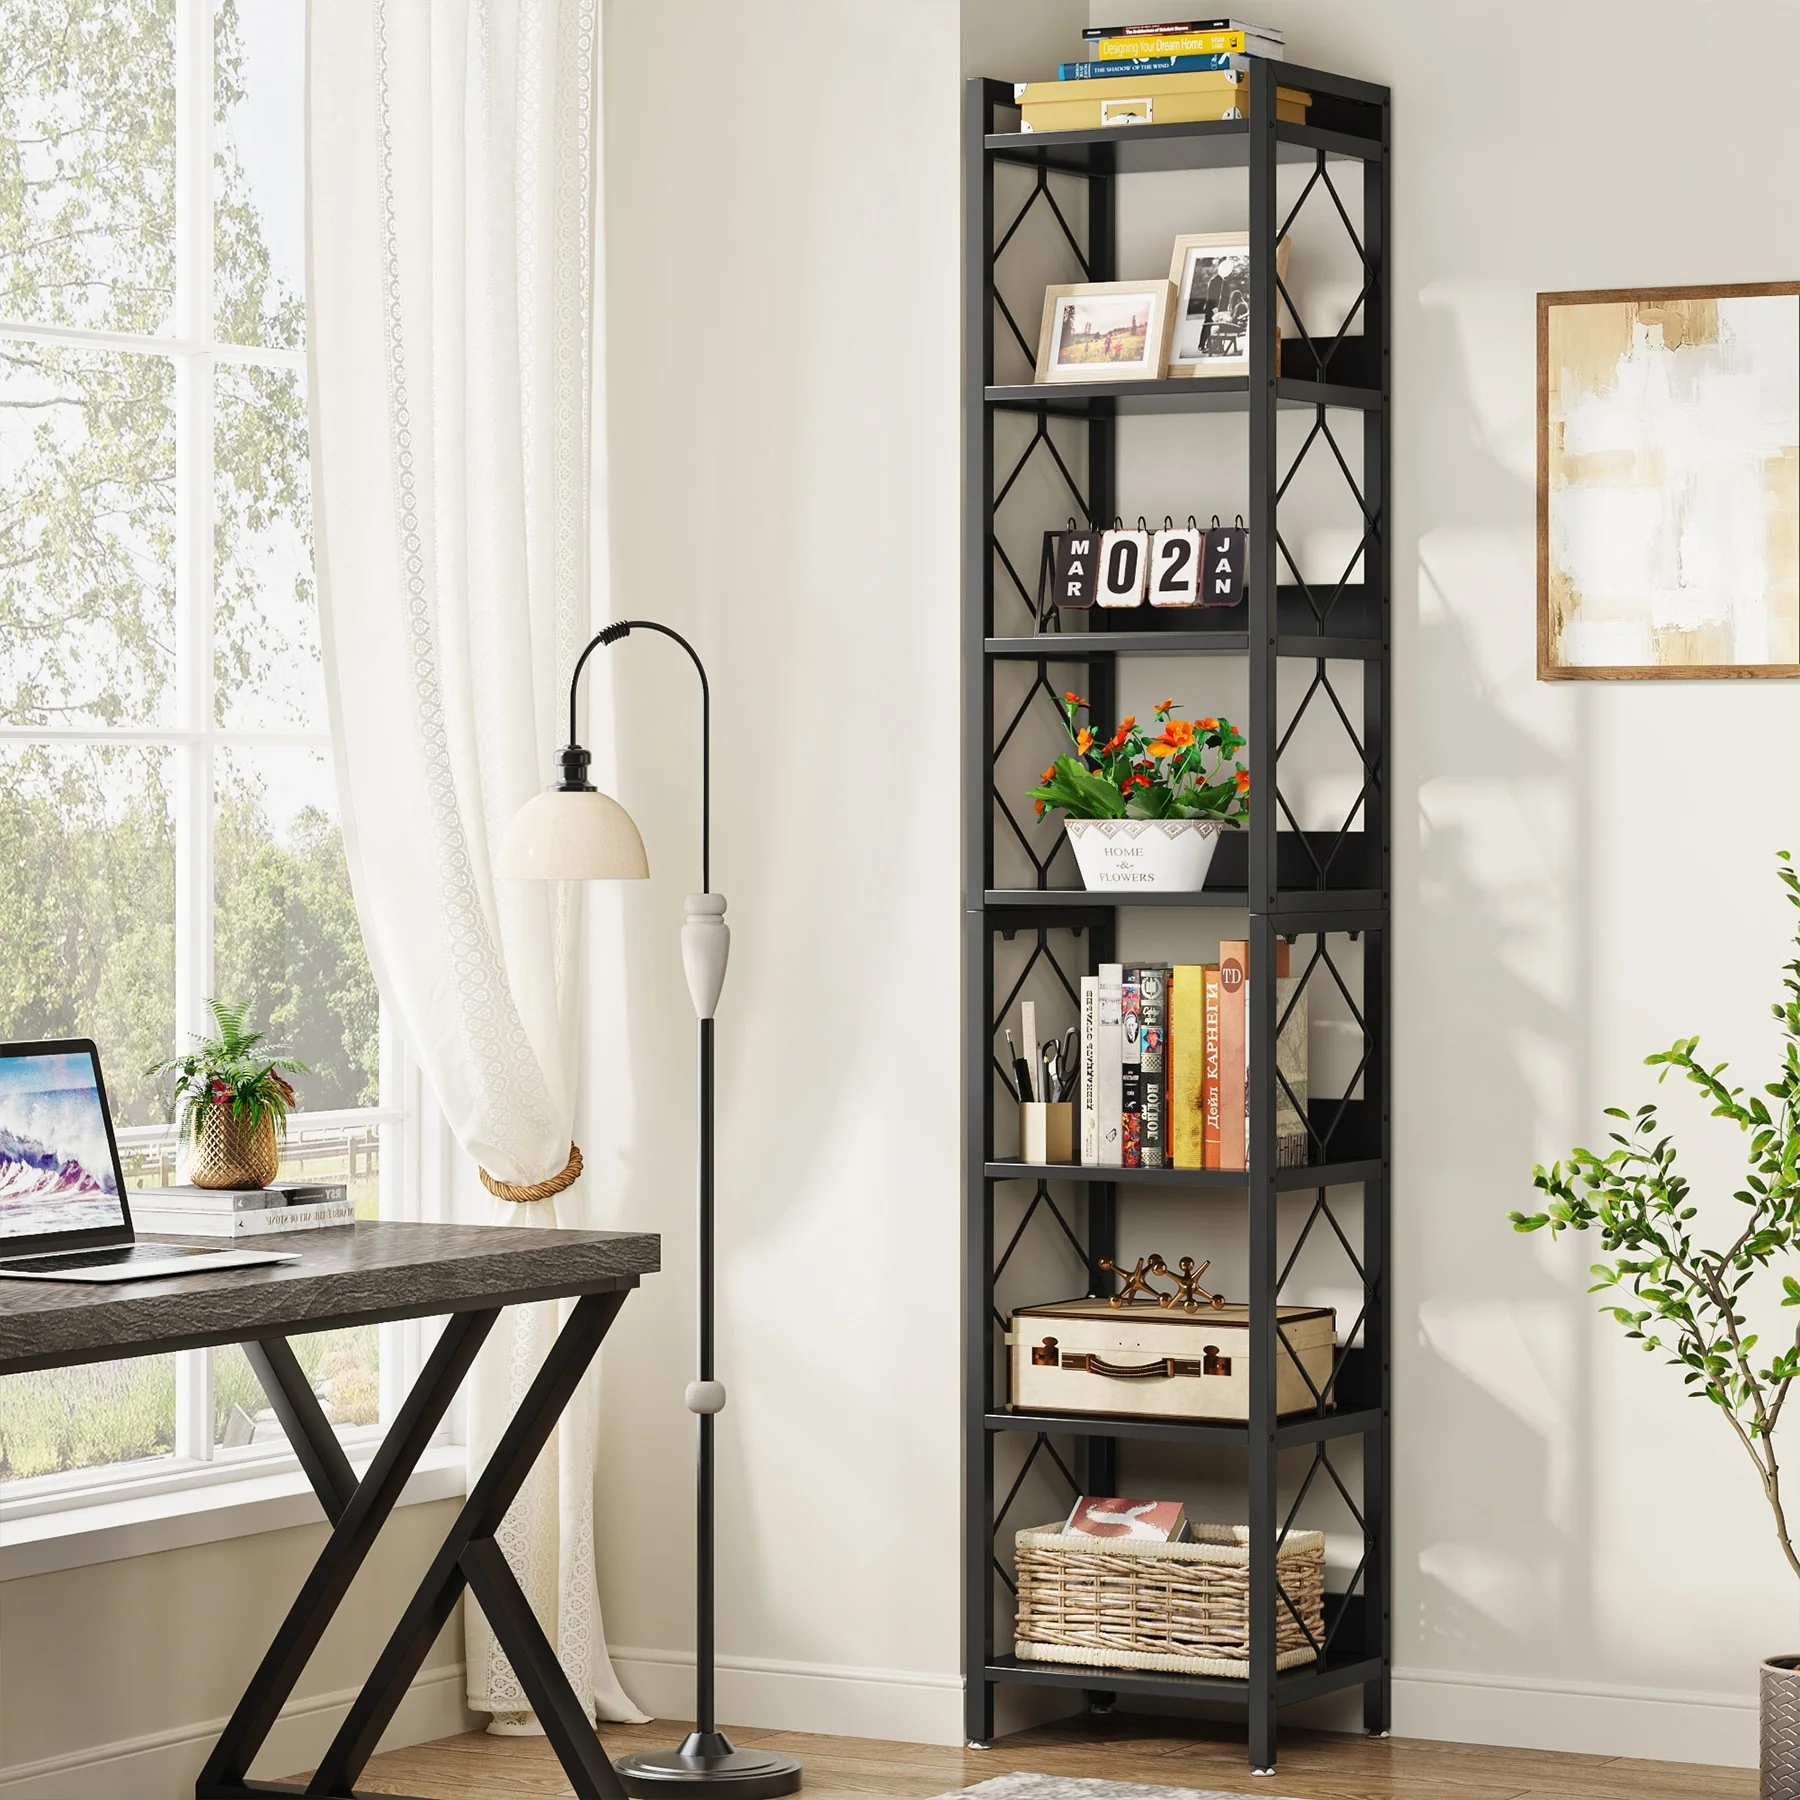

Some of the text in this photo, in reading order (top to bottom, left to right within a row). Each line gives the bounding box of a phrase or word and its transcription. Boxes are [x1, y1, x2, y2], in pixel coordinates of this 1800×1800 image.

[1103, 38, 1203, 57] Designing Your Dream Home
[1067, 540, 1089, 596] MAR
[1215, 537, 1231, 593] JAN
[1104, 847, 1144, 857] HOME
[1099, 873, 1155, 882] FLOWERS
[1222, 968, 1242, 985] TD
[1207, 982, 1220, 1129] Дейл КАРНЕГИ
[1146, 1083, 1159, 1140] ЛОНДОН
